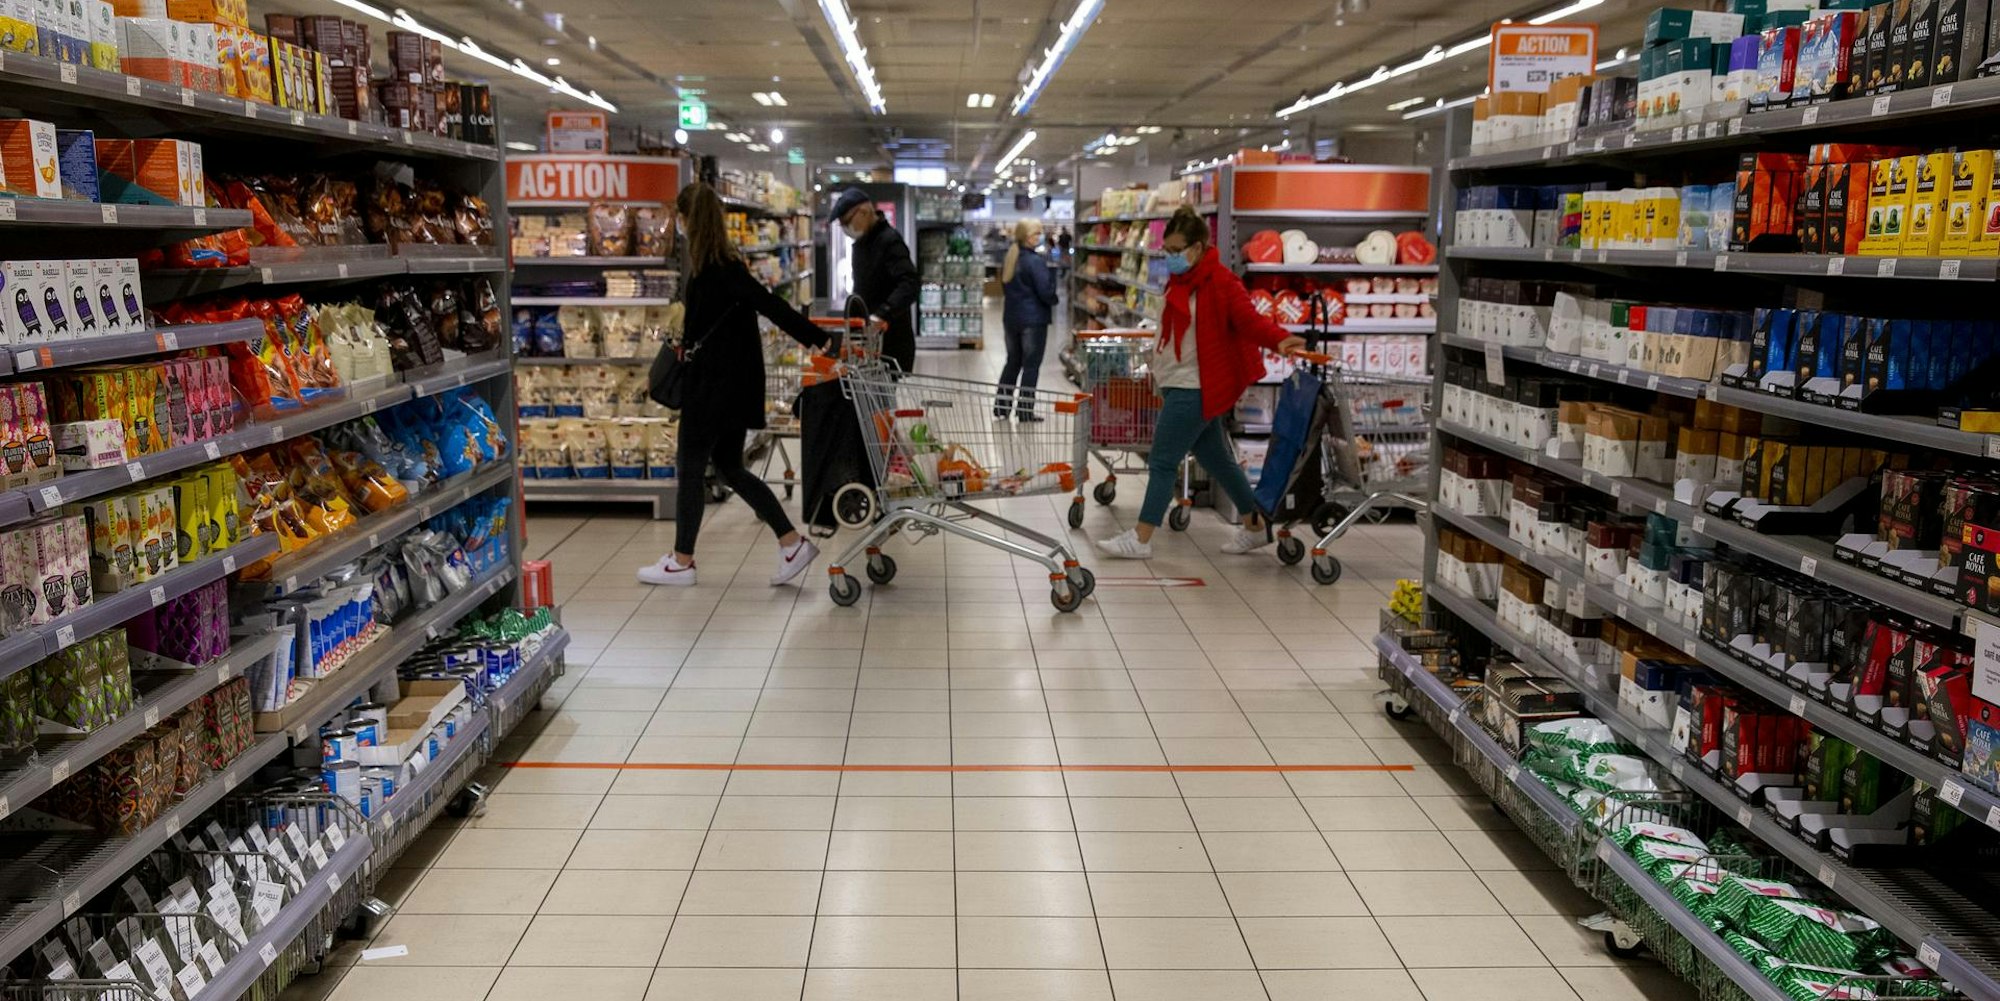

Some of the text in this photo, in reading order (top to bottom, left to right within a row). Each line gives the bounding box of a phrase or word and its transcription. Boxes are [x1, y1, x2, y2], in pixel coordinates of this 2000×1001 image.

[1517, 35, 1570, 53] ACTION
[562, 117, 592, 130] ACTION
[519, 162, 628, 198] ACTION
[1969, 552, 1985, 565] CAFÉ
[1965, 560, 1985, 575] ROYAL
[74, 576, 88, 588] ZEN
[46, 583, 64, 597] ZEN
[1976, 728, 1991, 740] CAFÉ
[1973, 736, 1991, 750] ROYAL
